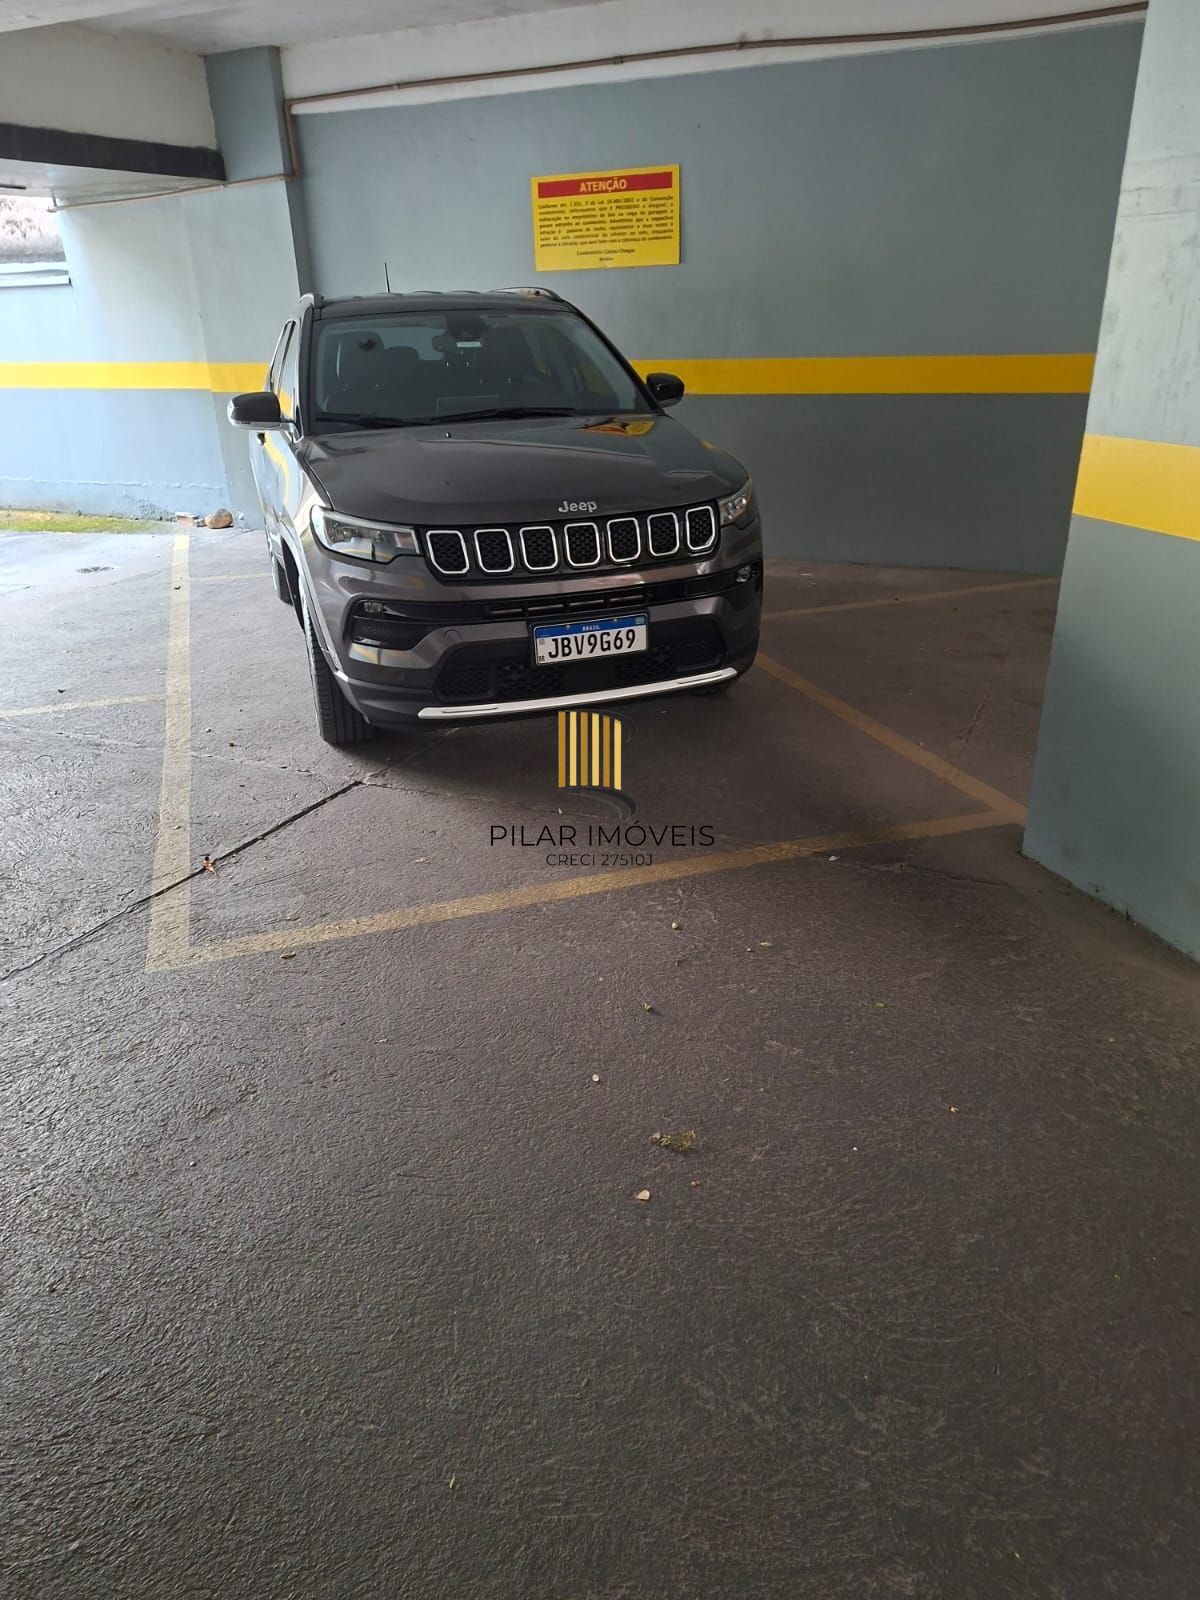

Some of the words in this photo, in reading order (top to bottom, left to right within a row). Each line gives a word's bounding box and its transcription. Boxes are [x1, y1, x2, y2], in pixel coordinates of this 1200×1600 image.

[580, 177, 627, 192] ATENÇÃO
[558, 500, 598, 513] Jeep
[548, 629, 636, 658] JBV9G69
